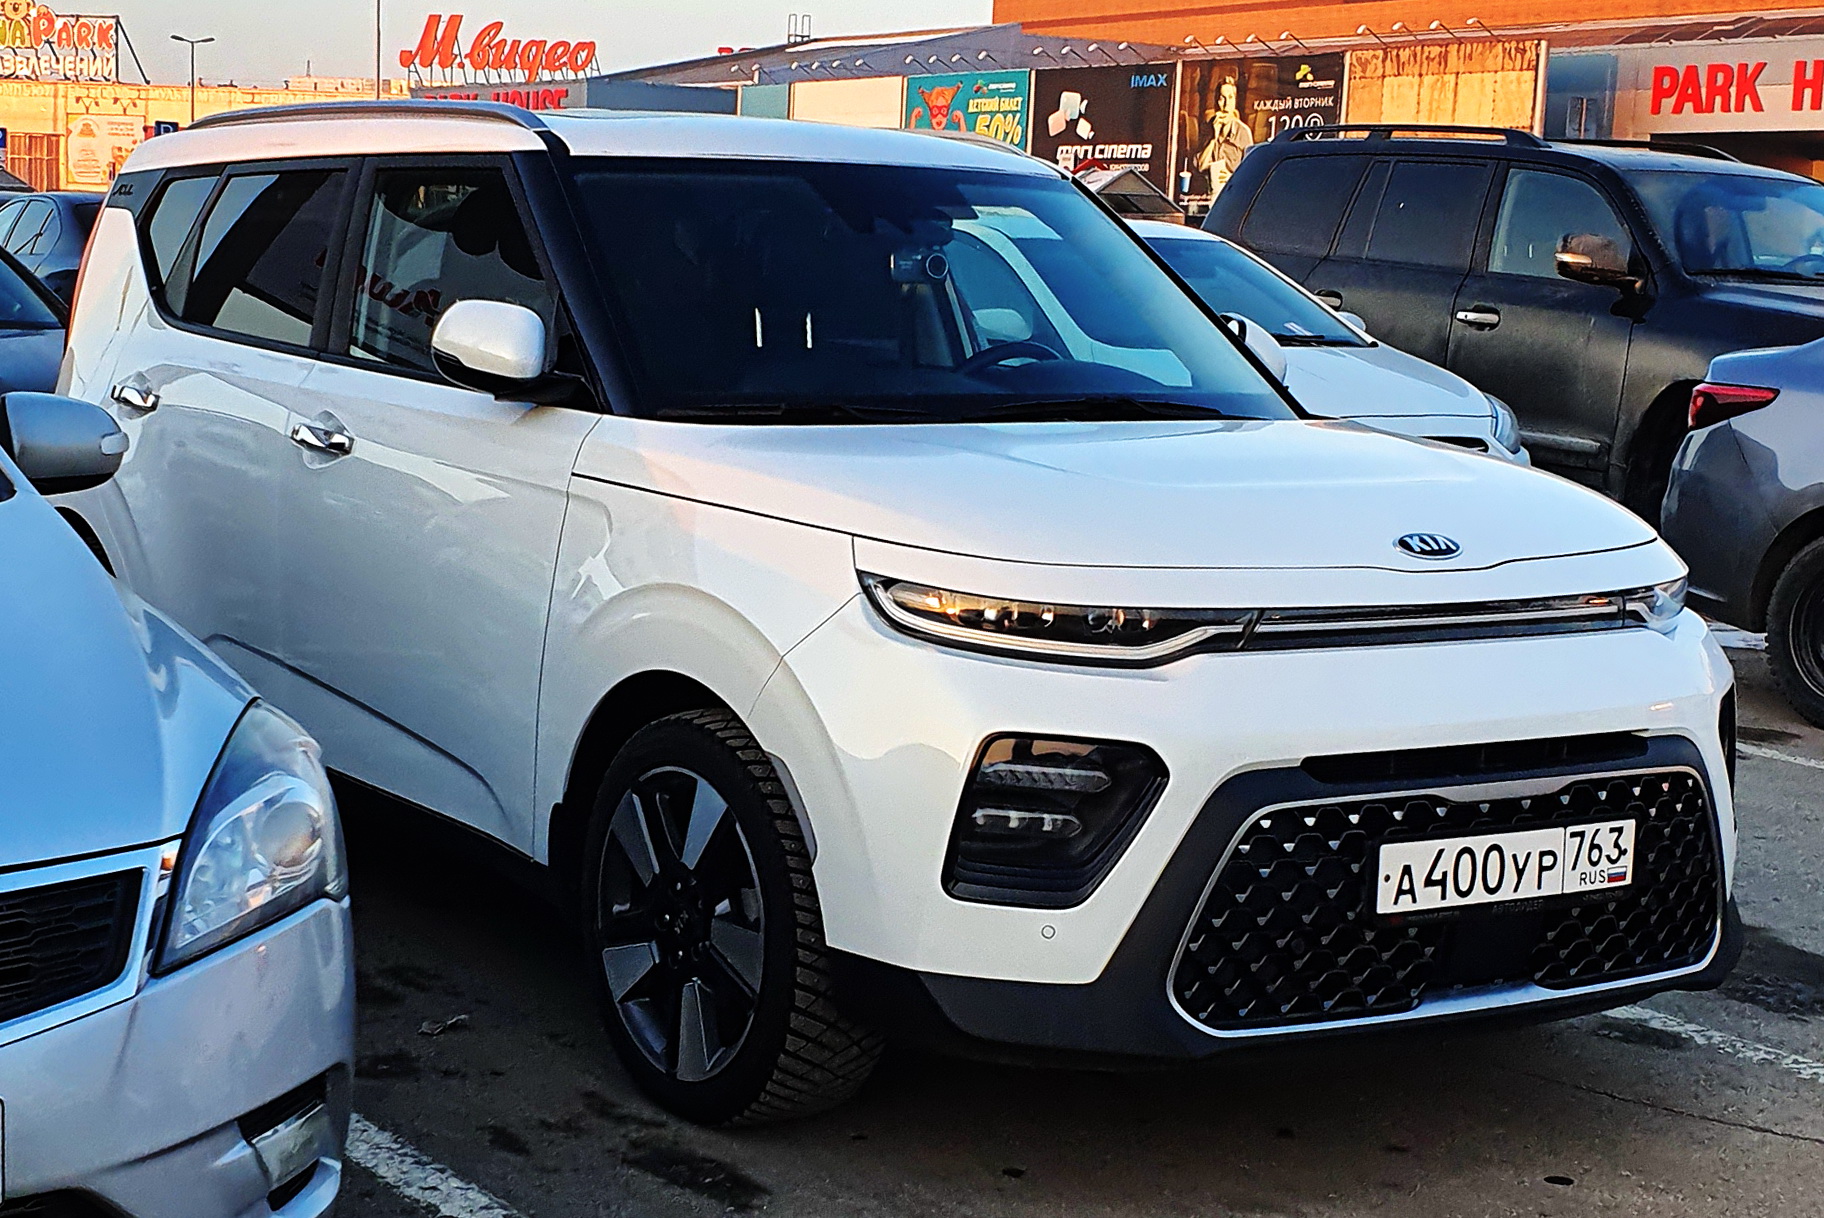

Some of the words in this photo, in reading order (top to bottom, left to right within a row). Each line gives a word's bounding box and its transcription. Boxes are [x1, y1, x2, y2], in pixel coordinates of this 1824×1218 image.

[32, 5, 114, 49] PARK
[1131, 74, 1168, 88] IMAX
[1650, 62, 1767, 115] PARK
[1253, 96, 1292, 111] КАЖДЫЙ
[1294, 96, 1335, 109] ВТОРНИК
[975, 113, 1022, 145] 50%
[1094, 144, 1152, 159] cinema
[1402, 534, 1456, 553] KIA
[1569, 825, 1625, 872] 763
[1579, 871, 1606, 887] RUS
